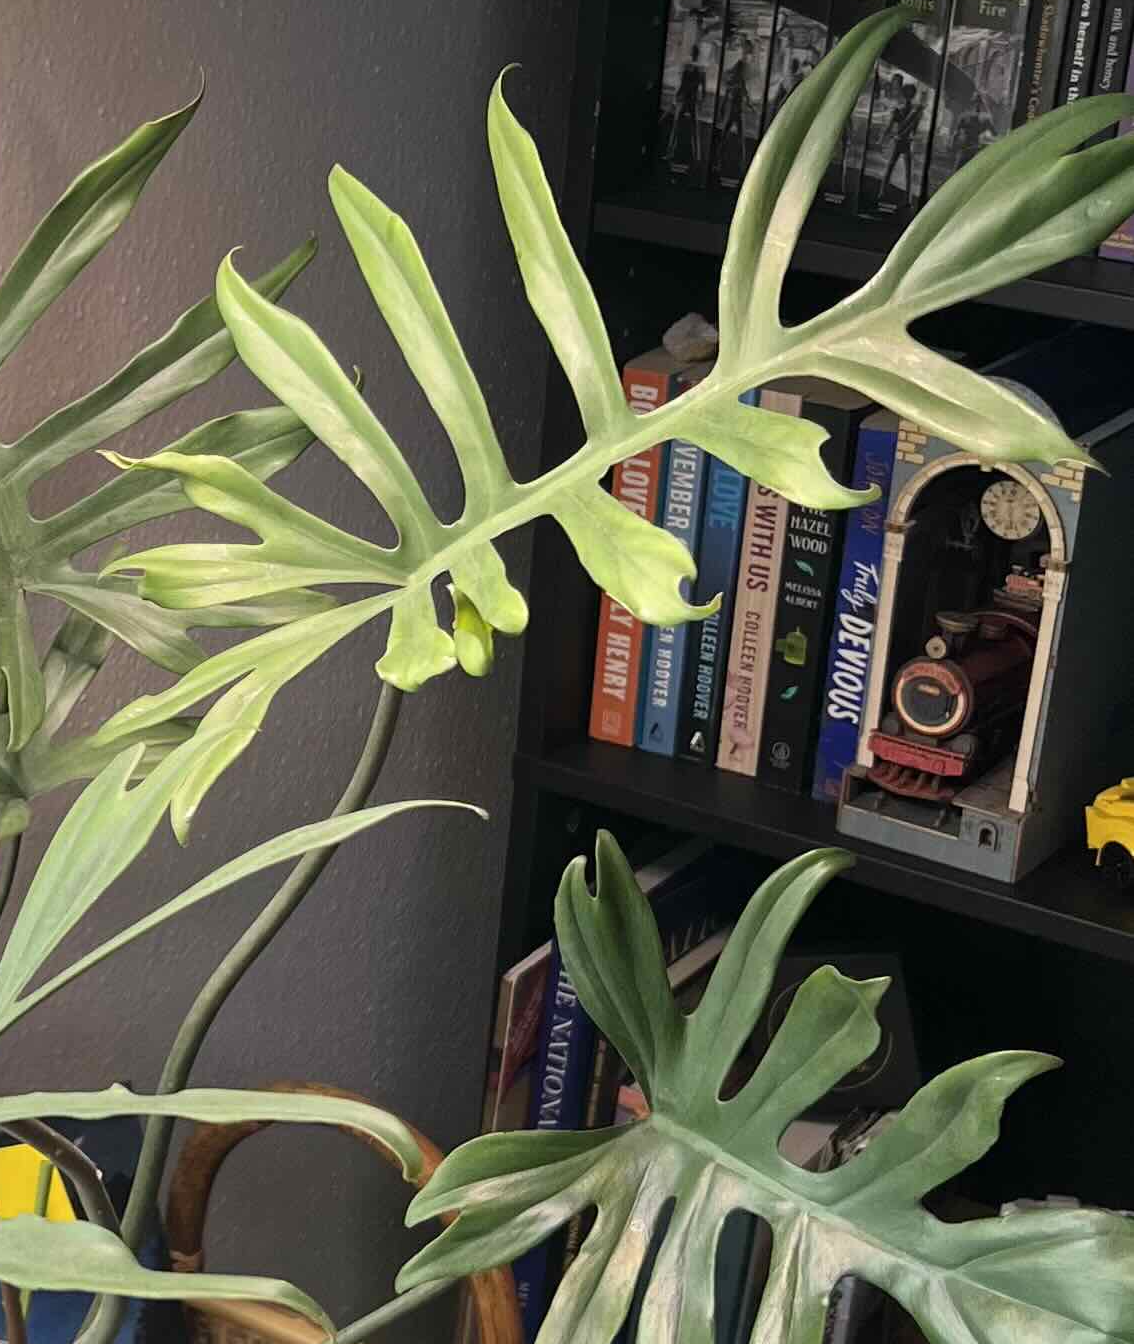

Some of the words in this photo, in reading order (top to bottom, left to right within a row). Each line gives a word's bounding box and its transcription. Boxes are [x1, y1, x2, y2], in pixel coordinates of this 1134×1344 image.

[979, 0, 1007, 17] Fire
[667, 445, 698, 529] VEMBER
[750, 505, 778, 559] WITH
[788, 534, 828, 555] WOOD
[790, 515, 831, 538] HAZEL
[746, 564, 771, 593] US
[841, 559, 879, 614] Truly
[602, 631, 632, 704] HENRY
[739, 610, 761, 672] COLLEEN
[826, 612, 874, 725] DEVIOUS
[651, 648, 673, 708] HOOVER
[693, 663, 714, 720] HOOVER
[733, 675, 753, 729] HOOVER
[537, 1013, 574, 1127] NATIONA
